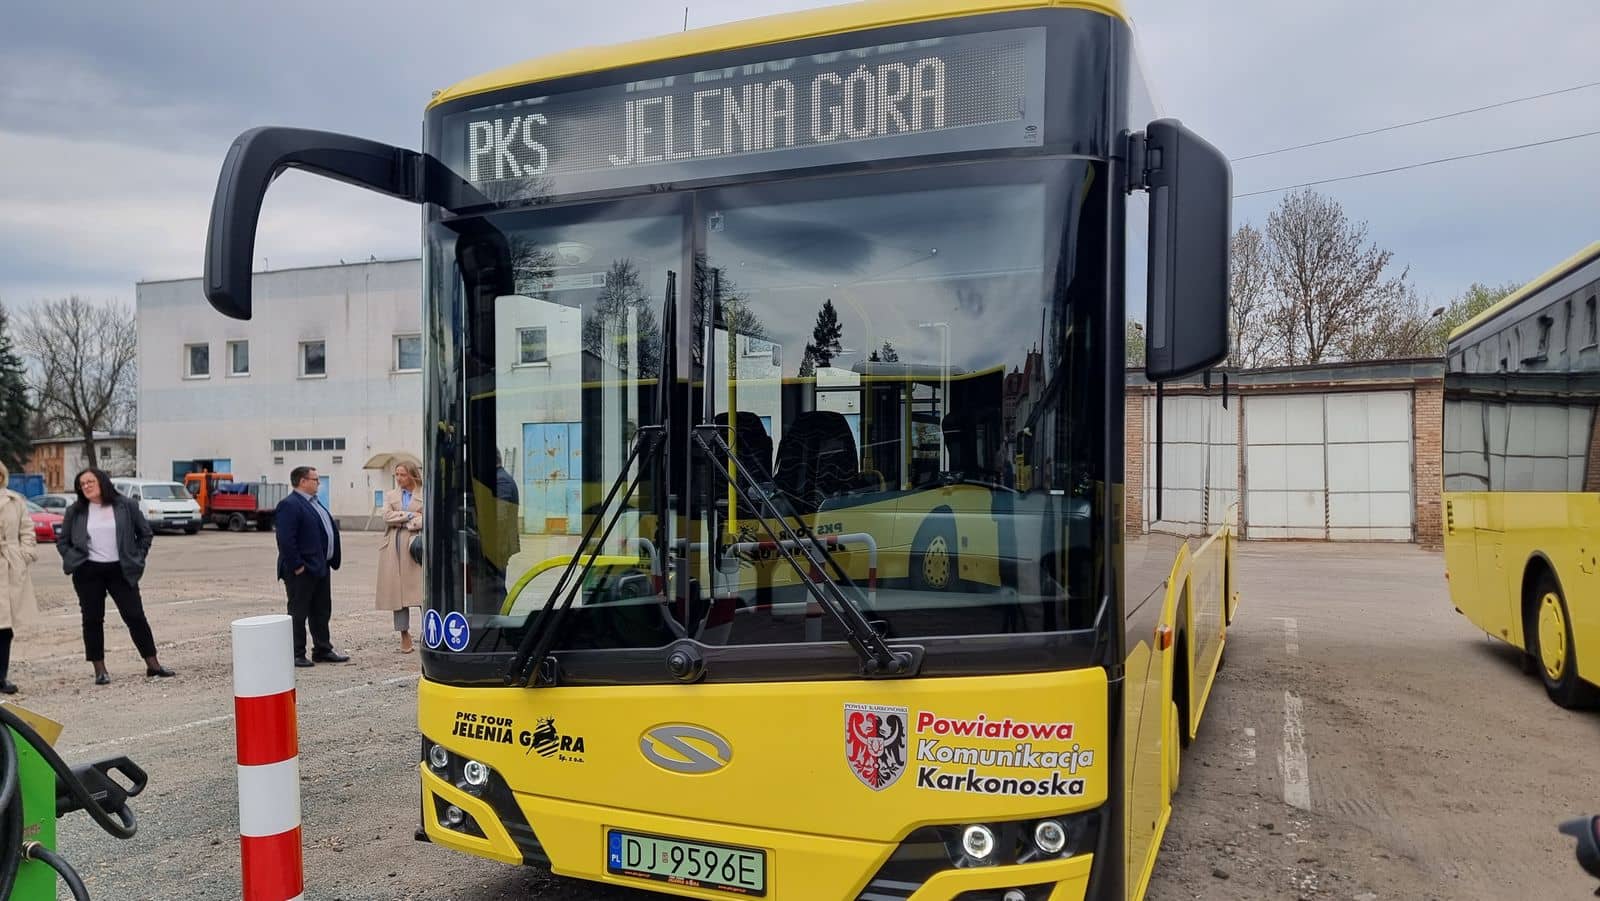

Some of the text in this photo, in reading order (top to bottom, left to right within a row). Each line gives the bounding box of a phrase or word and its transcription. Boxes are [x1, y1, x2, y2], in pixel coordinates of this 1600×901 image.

[469, 113, 548, 182] PKS
[608, 79, 795, 167] JELENIA
[811, 56, 946, 143] GÓRA
[452, 721, 513, 745] JELENIA
[456, 711, 513, 727] PKS TOUR
[916, 712, 1074, 740] Powiatowa
[916, 739, 1094, 774] Komunikacja
[917, 766, 1085, 796] Karkonoska
[611, 854, 621, 863] PL
[627, 838, 755, 885] DJ 9596E
